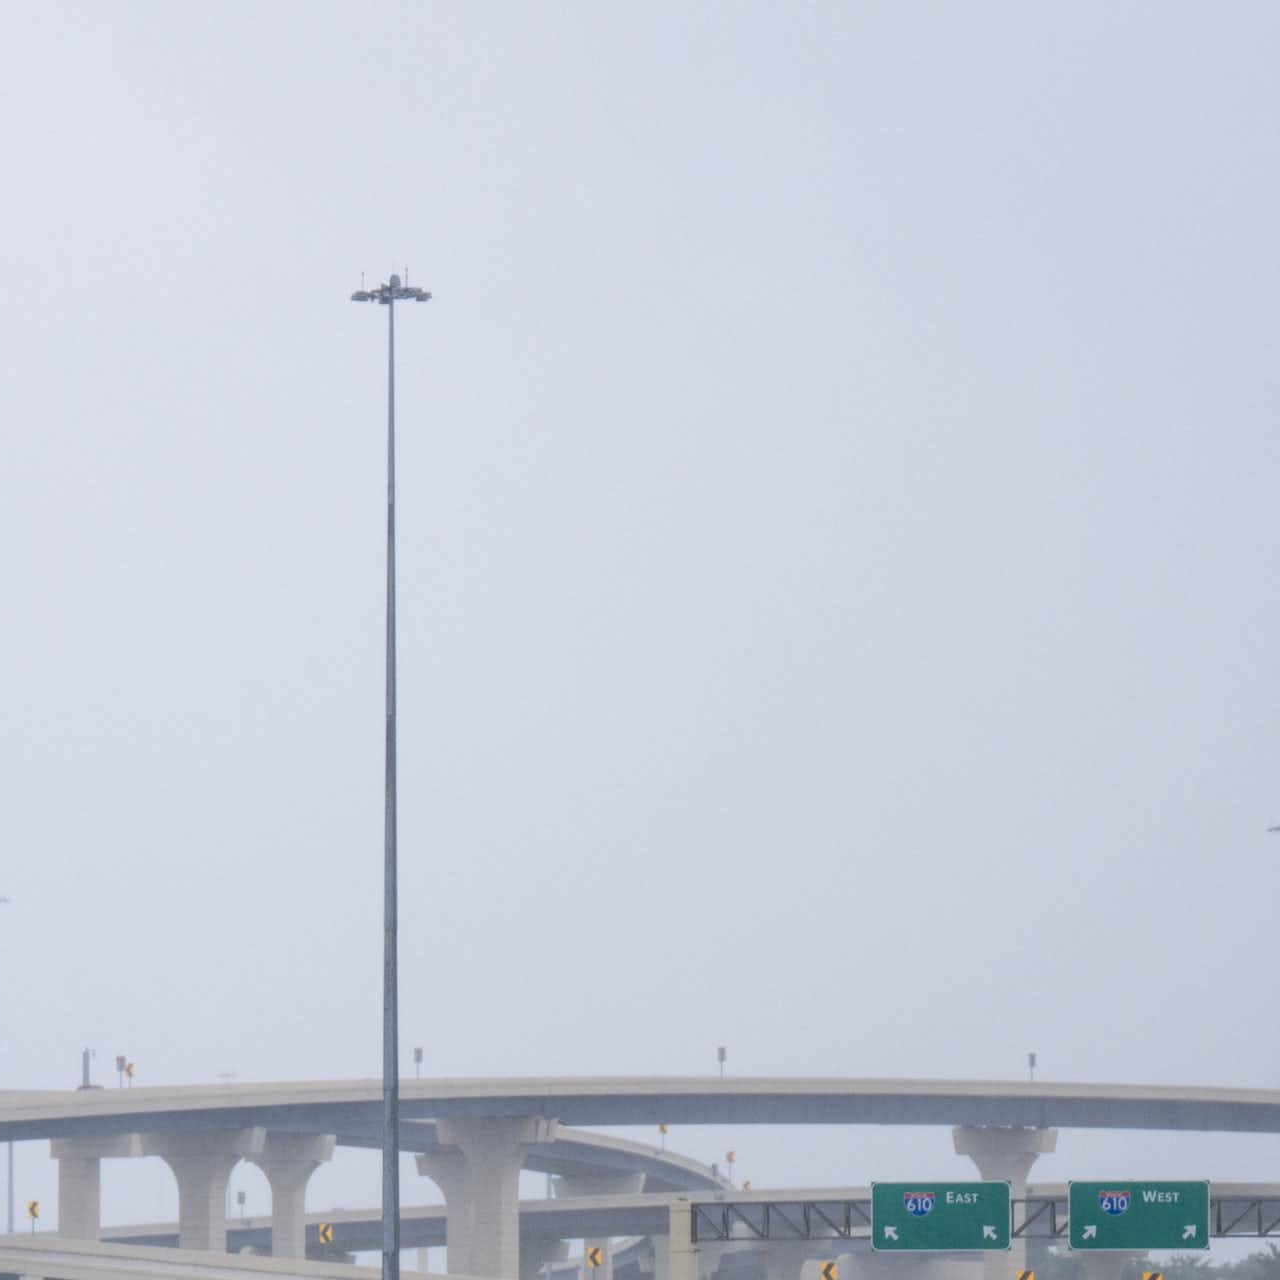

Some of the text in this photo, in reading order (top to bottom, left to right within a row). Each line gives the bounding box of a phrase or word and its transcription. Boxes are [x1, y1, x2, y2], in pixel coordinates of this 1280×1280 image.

[906, 1198, 933, 1212] 610
[945, 1191, 979, 1204] EAST
[1102, 1197, 1128, 1211] 610
[1142, 1189, 1181, 1203] WEST
